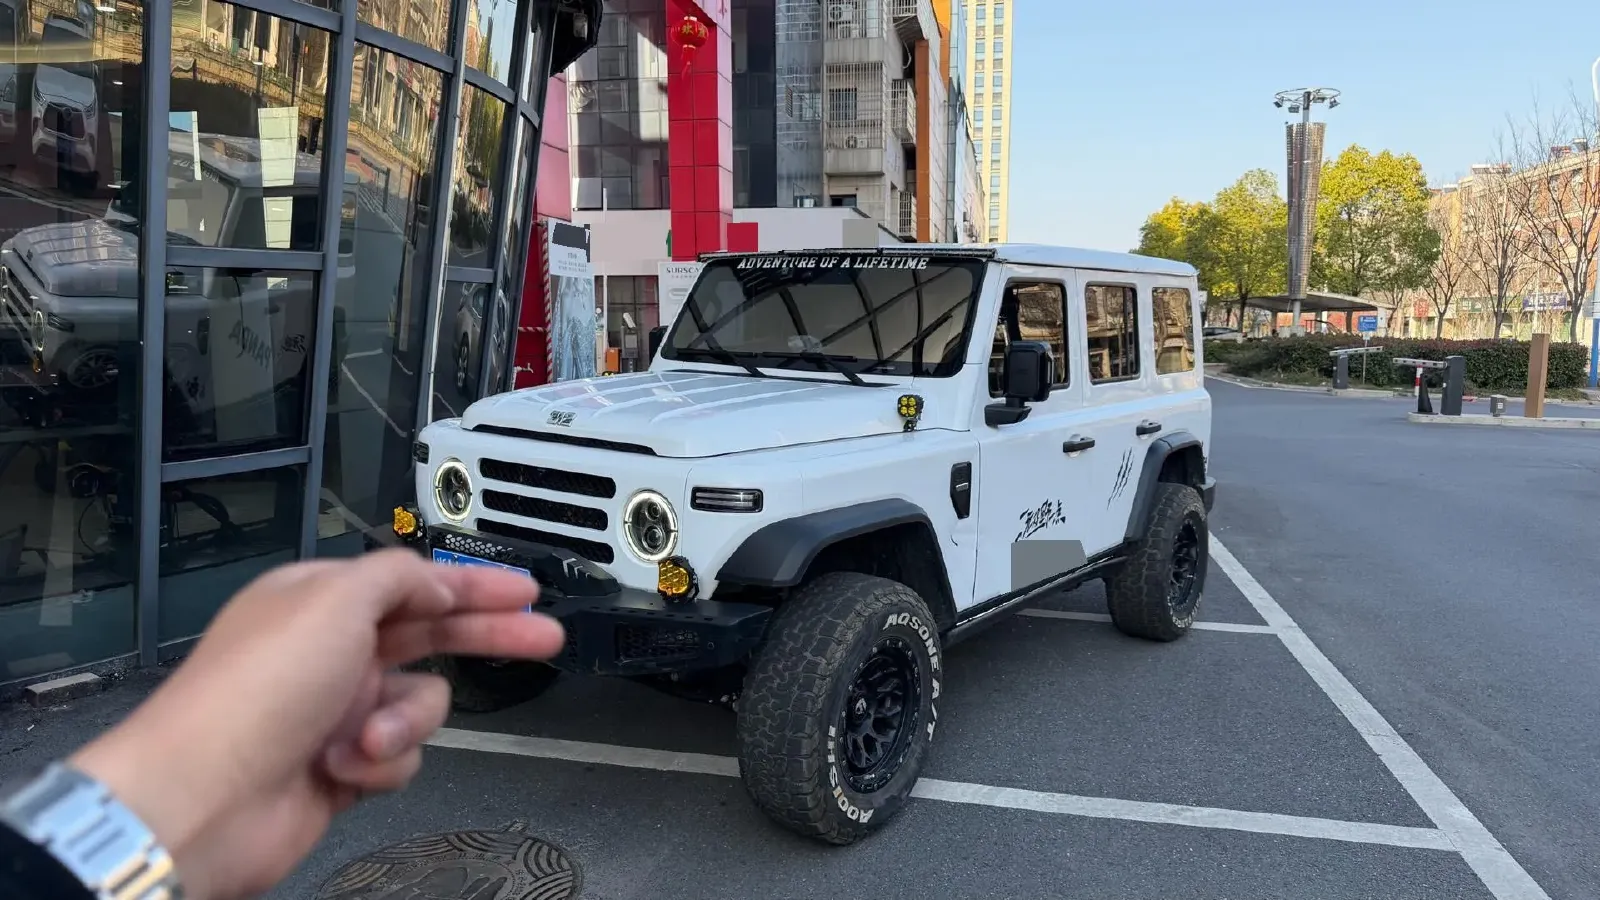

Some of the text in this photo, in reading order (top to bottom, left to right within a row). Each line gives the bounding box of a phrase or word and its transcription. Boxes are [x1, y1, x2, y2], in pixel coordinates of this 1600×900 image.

[737, 257, 930, 269] ADVENTURE OF A LIFETIME
[927, 677, 940, 742] A/T
